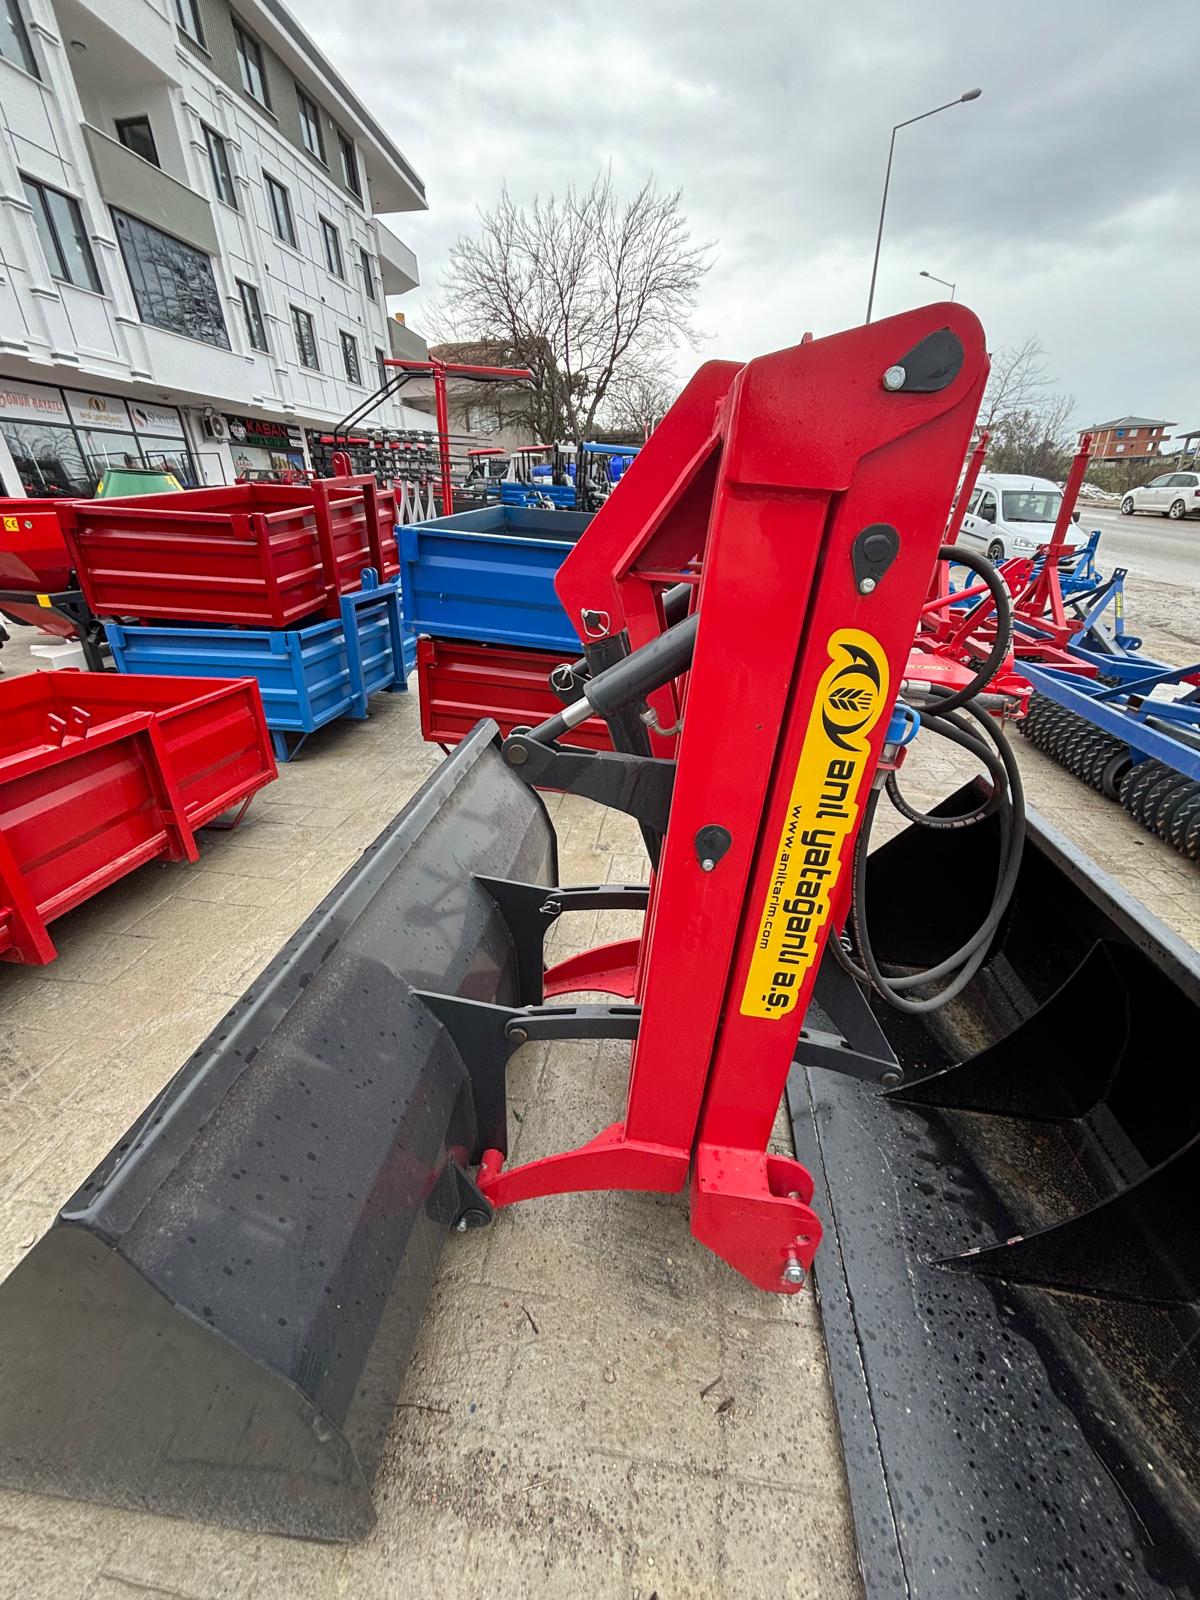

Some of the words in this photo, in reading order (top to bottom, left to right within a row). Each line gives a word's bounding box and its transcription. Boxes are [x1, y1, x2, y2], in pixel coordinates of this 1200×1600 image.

[246, 420, 287, 437] KABAN
[816, 759, 856, 819] anıl
[777, 829, 837, 965] yatağanlı
[761, 971, 796, 1012] a.ş.
